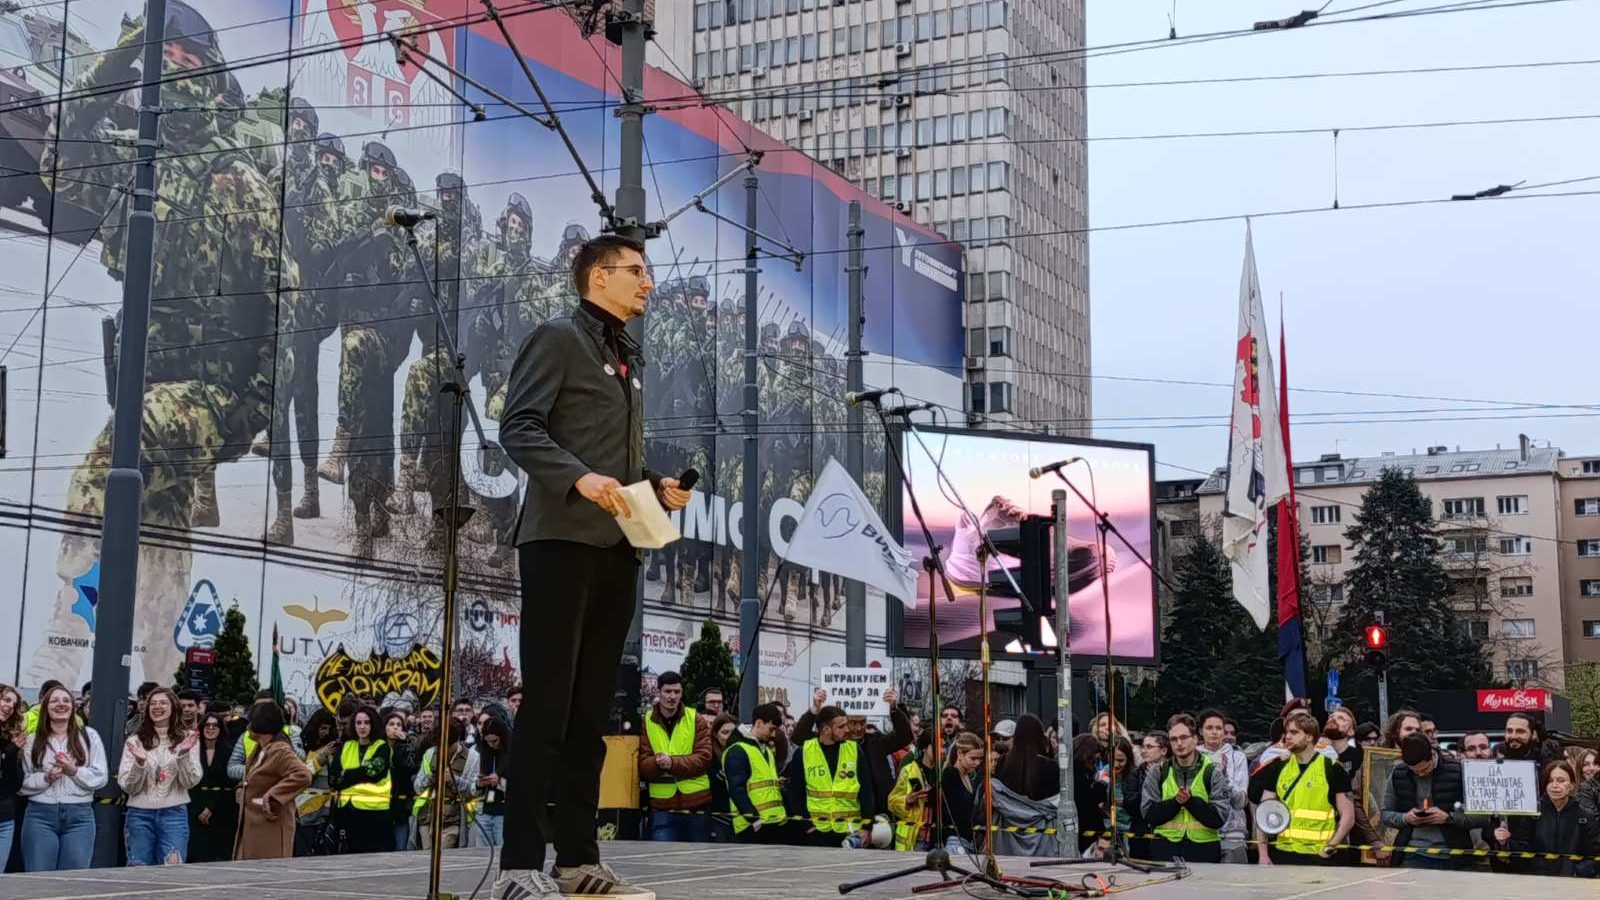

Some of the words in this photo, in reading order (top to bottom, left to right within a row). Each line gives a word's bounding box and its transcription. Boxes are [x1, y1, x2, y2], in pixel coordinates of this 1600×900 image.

[49, 636, 89, 648] КОВАЧКИ
[641, 633, 686, 650] menska
[383, 648, 440, 672] ДАНАС
[318, 667, 440, 714] БЛОКИРАМ
[867, 687, 879, 697] ЗА
[1488, 765, 1503, 777] ДА
[1513, 788, 1526, 800] ДА
